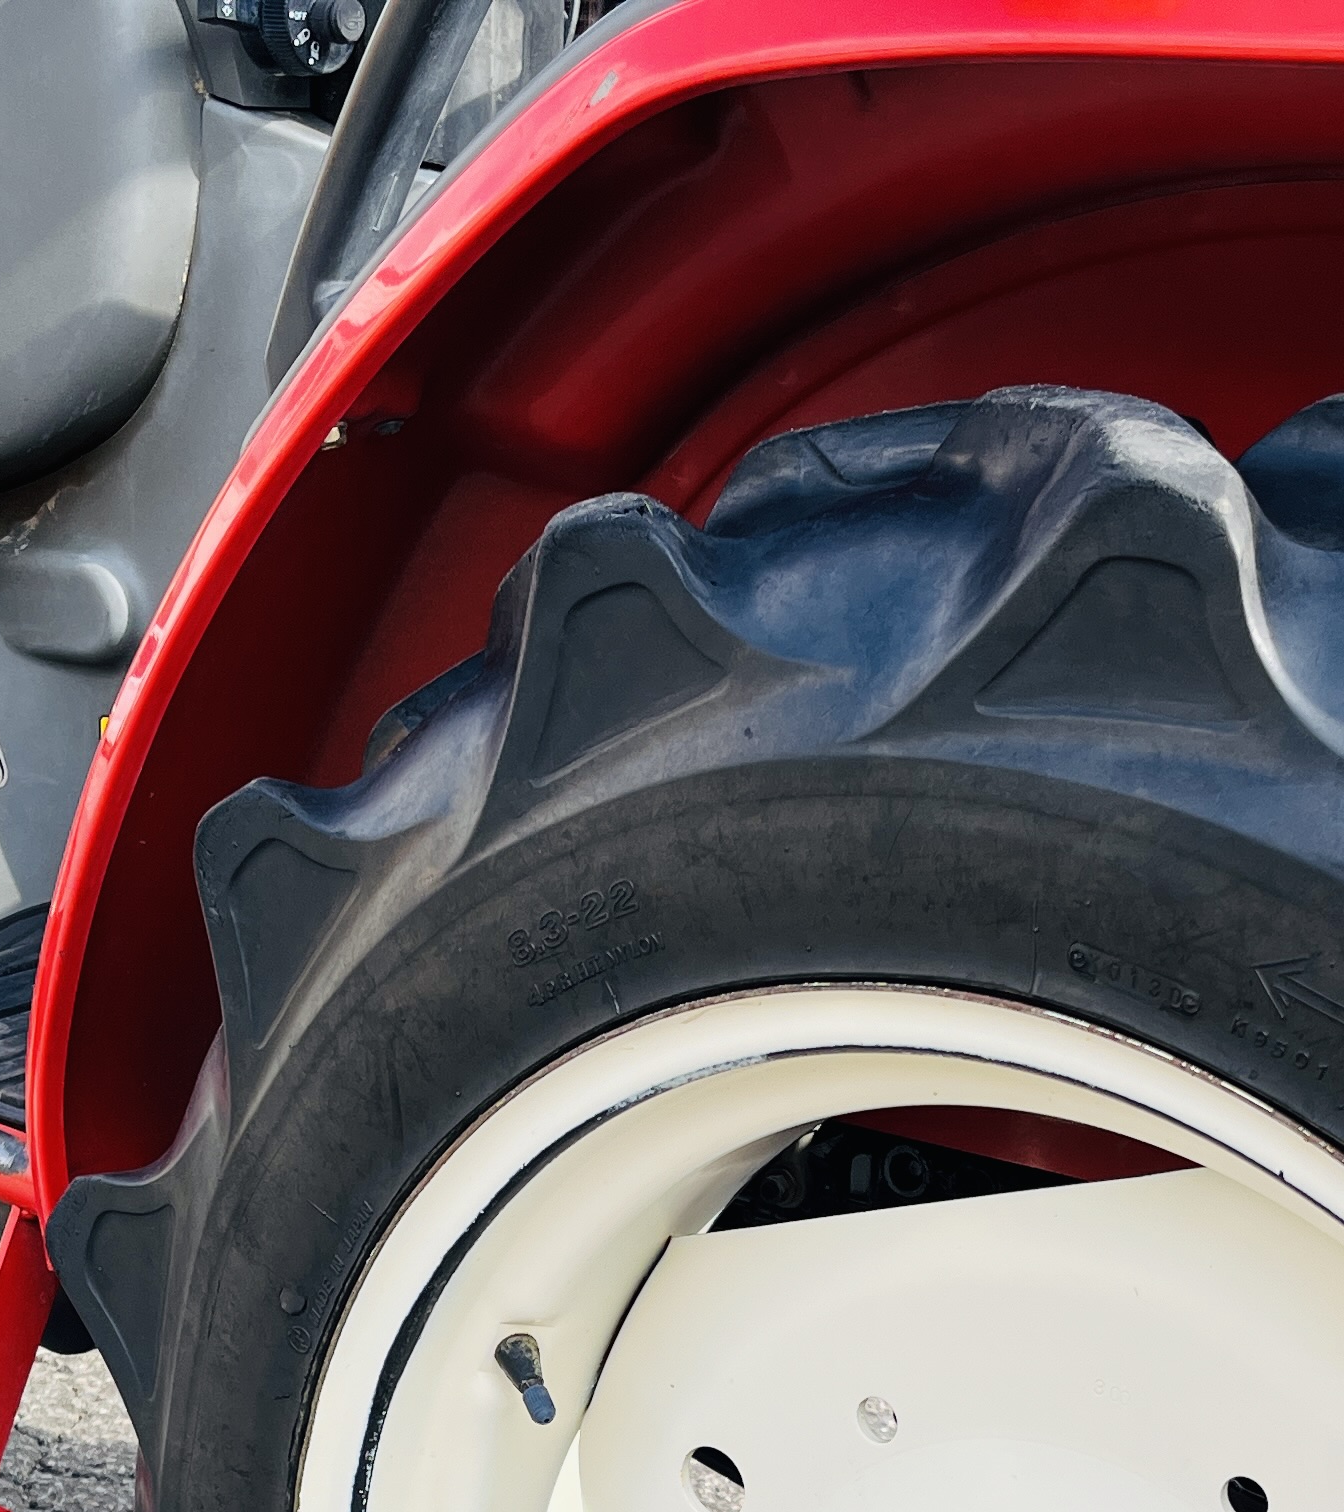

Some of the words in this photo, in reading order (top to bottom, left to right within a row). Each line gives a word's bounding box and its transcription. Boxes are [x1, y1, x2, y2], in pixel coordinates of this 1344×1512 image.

[507, 878, 639, 967] 8.3-22
[308, 1279, 336, 1328] MADE
[328, 1254, 348, 1276] IN
[341, 1198, 376, 1250] JAPAN
